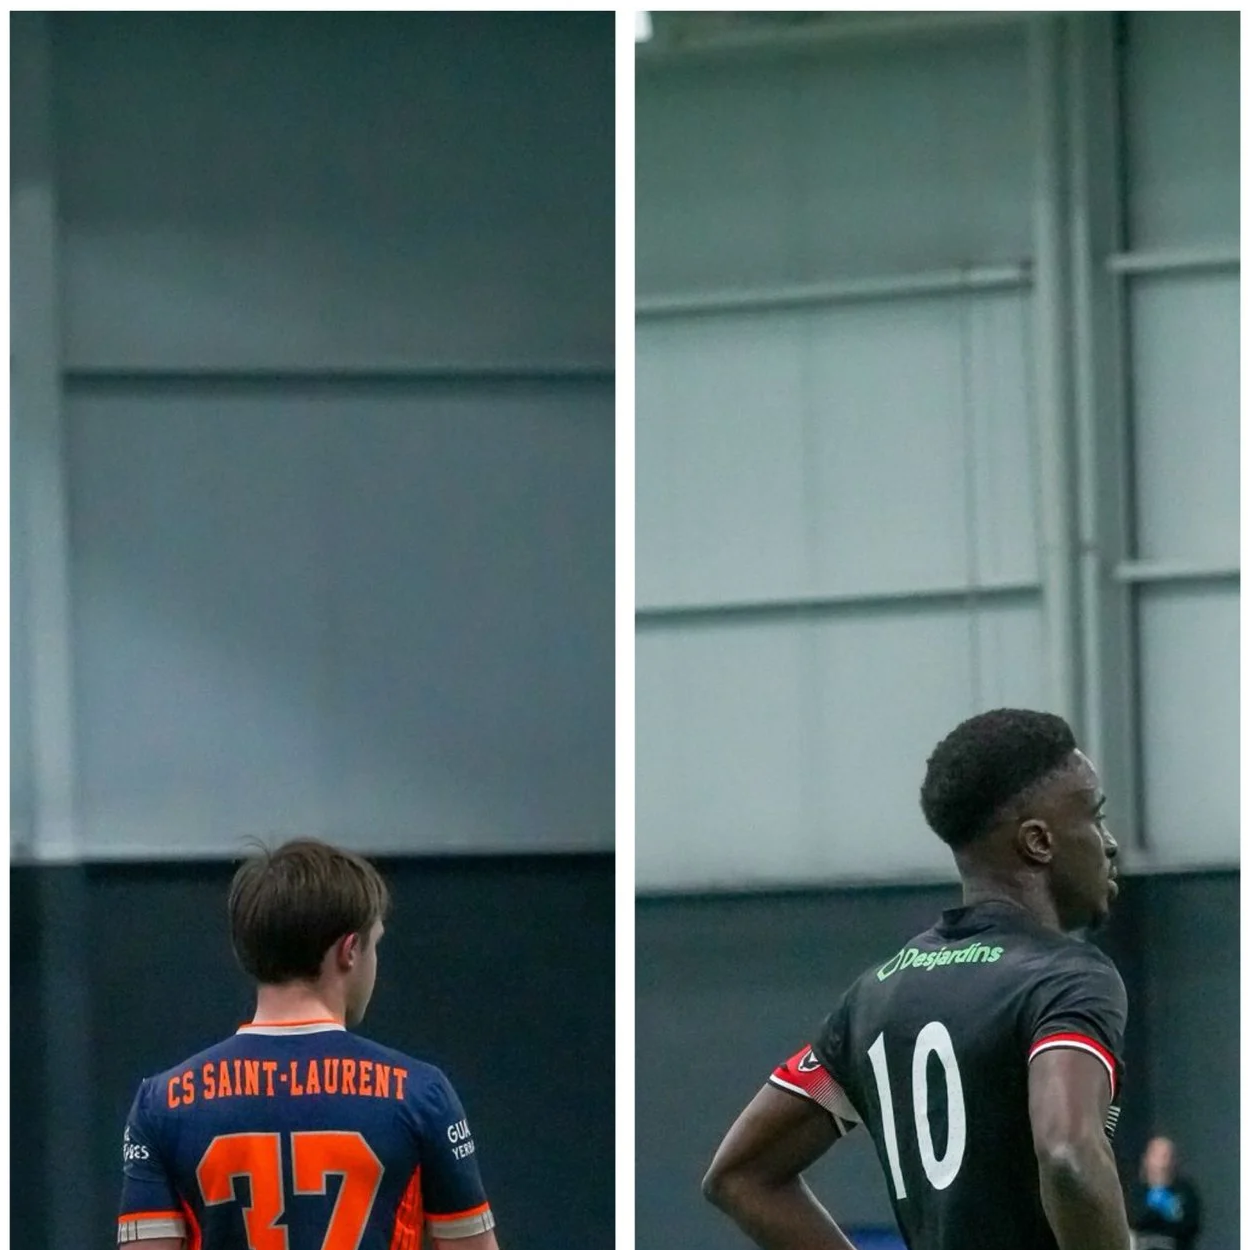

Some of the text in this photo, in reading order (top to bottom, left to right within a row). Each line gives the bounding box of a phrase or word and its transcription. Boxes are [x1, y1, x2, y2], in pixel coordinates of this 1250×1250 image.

[899, 942, 1004, 971] Desjardins
[167, 1058, 407, 1108] CS SAINT-LAURENT
[867, 1021, 966, 1200] 10
